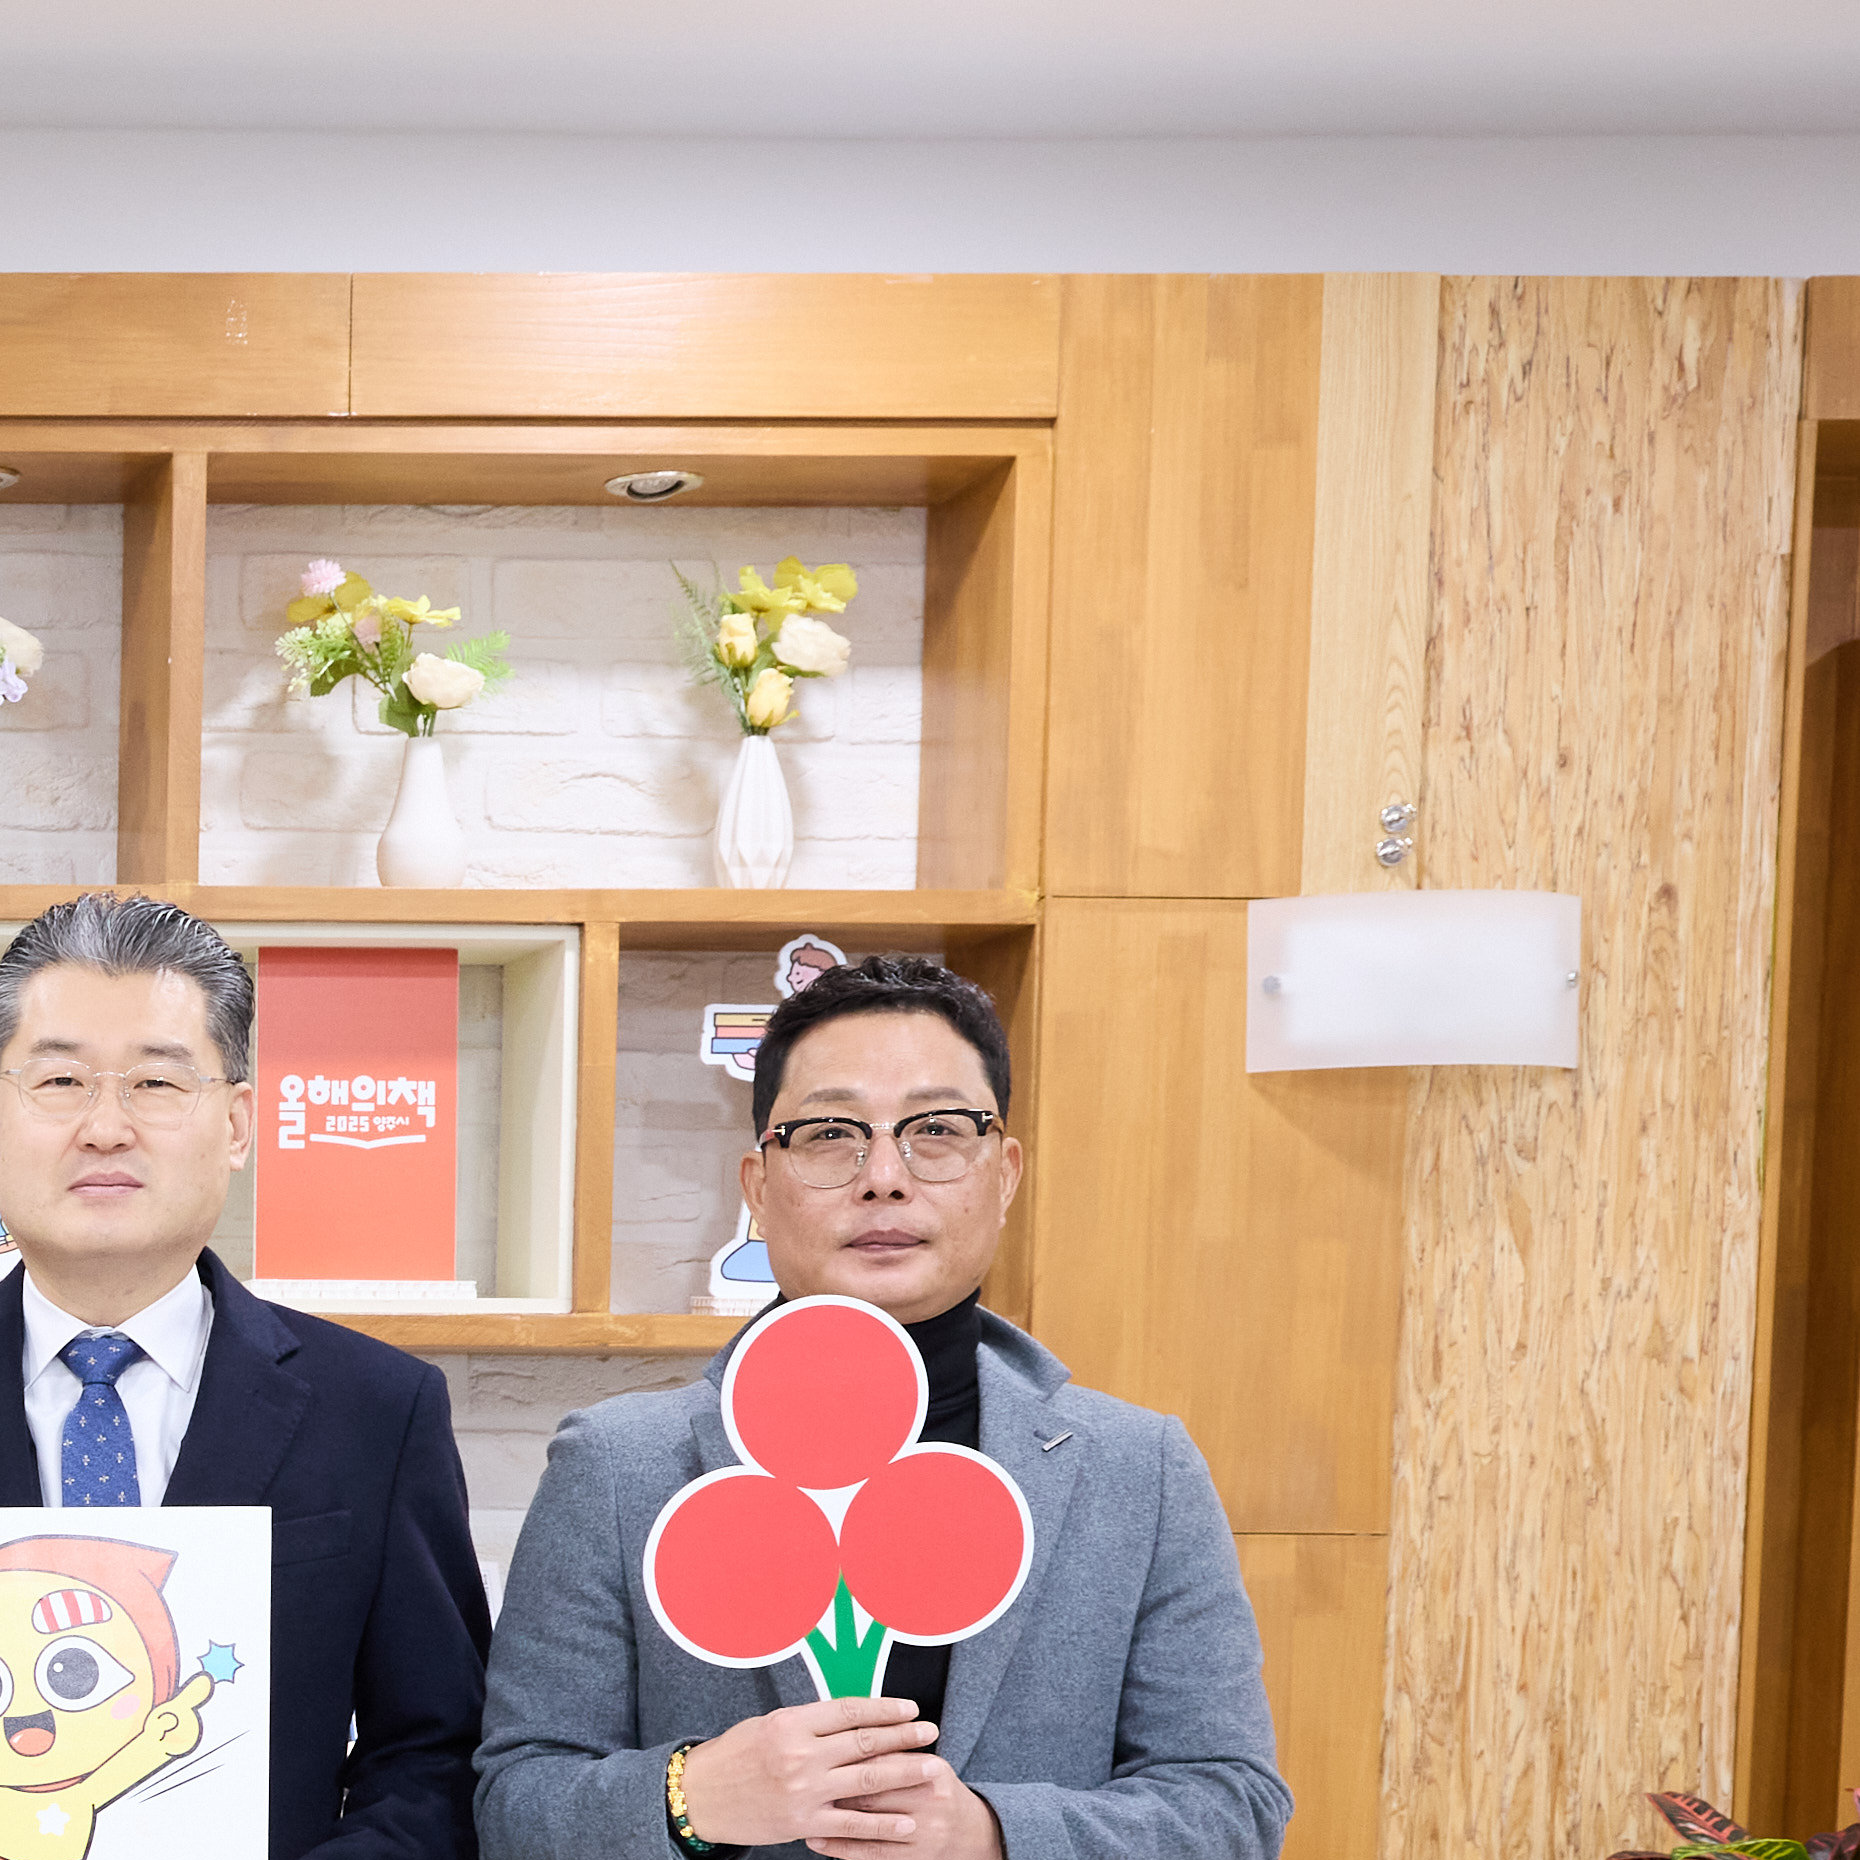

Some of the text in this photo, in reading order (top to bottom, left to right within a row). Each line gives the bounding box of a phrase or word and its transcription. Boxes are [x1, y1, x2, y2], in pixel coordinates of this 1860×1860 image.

[278, 1074, 436, 1149] 올해의책
[326, 1115, 410, 1132] 2025 양주시
